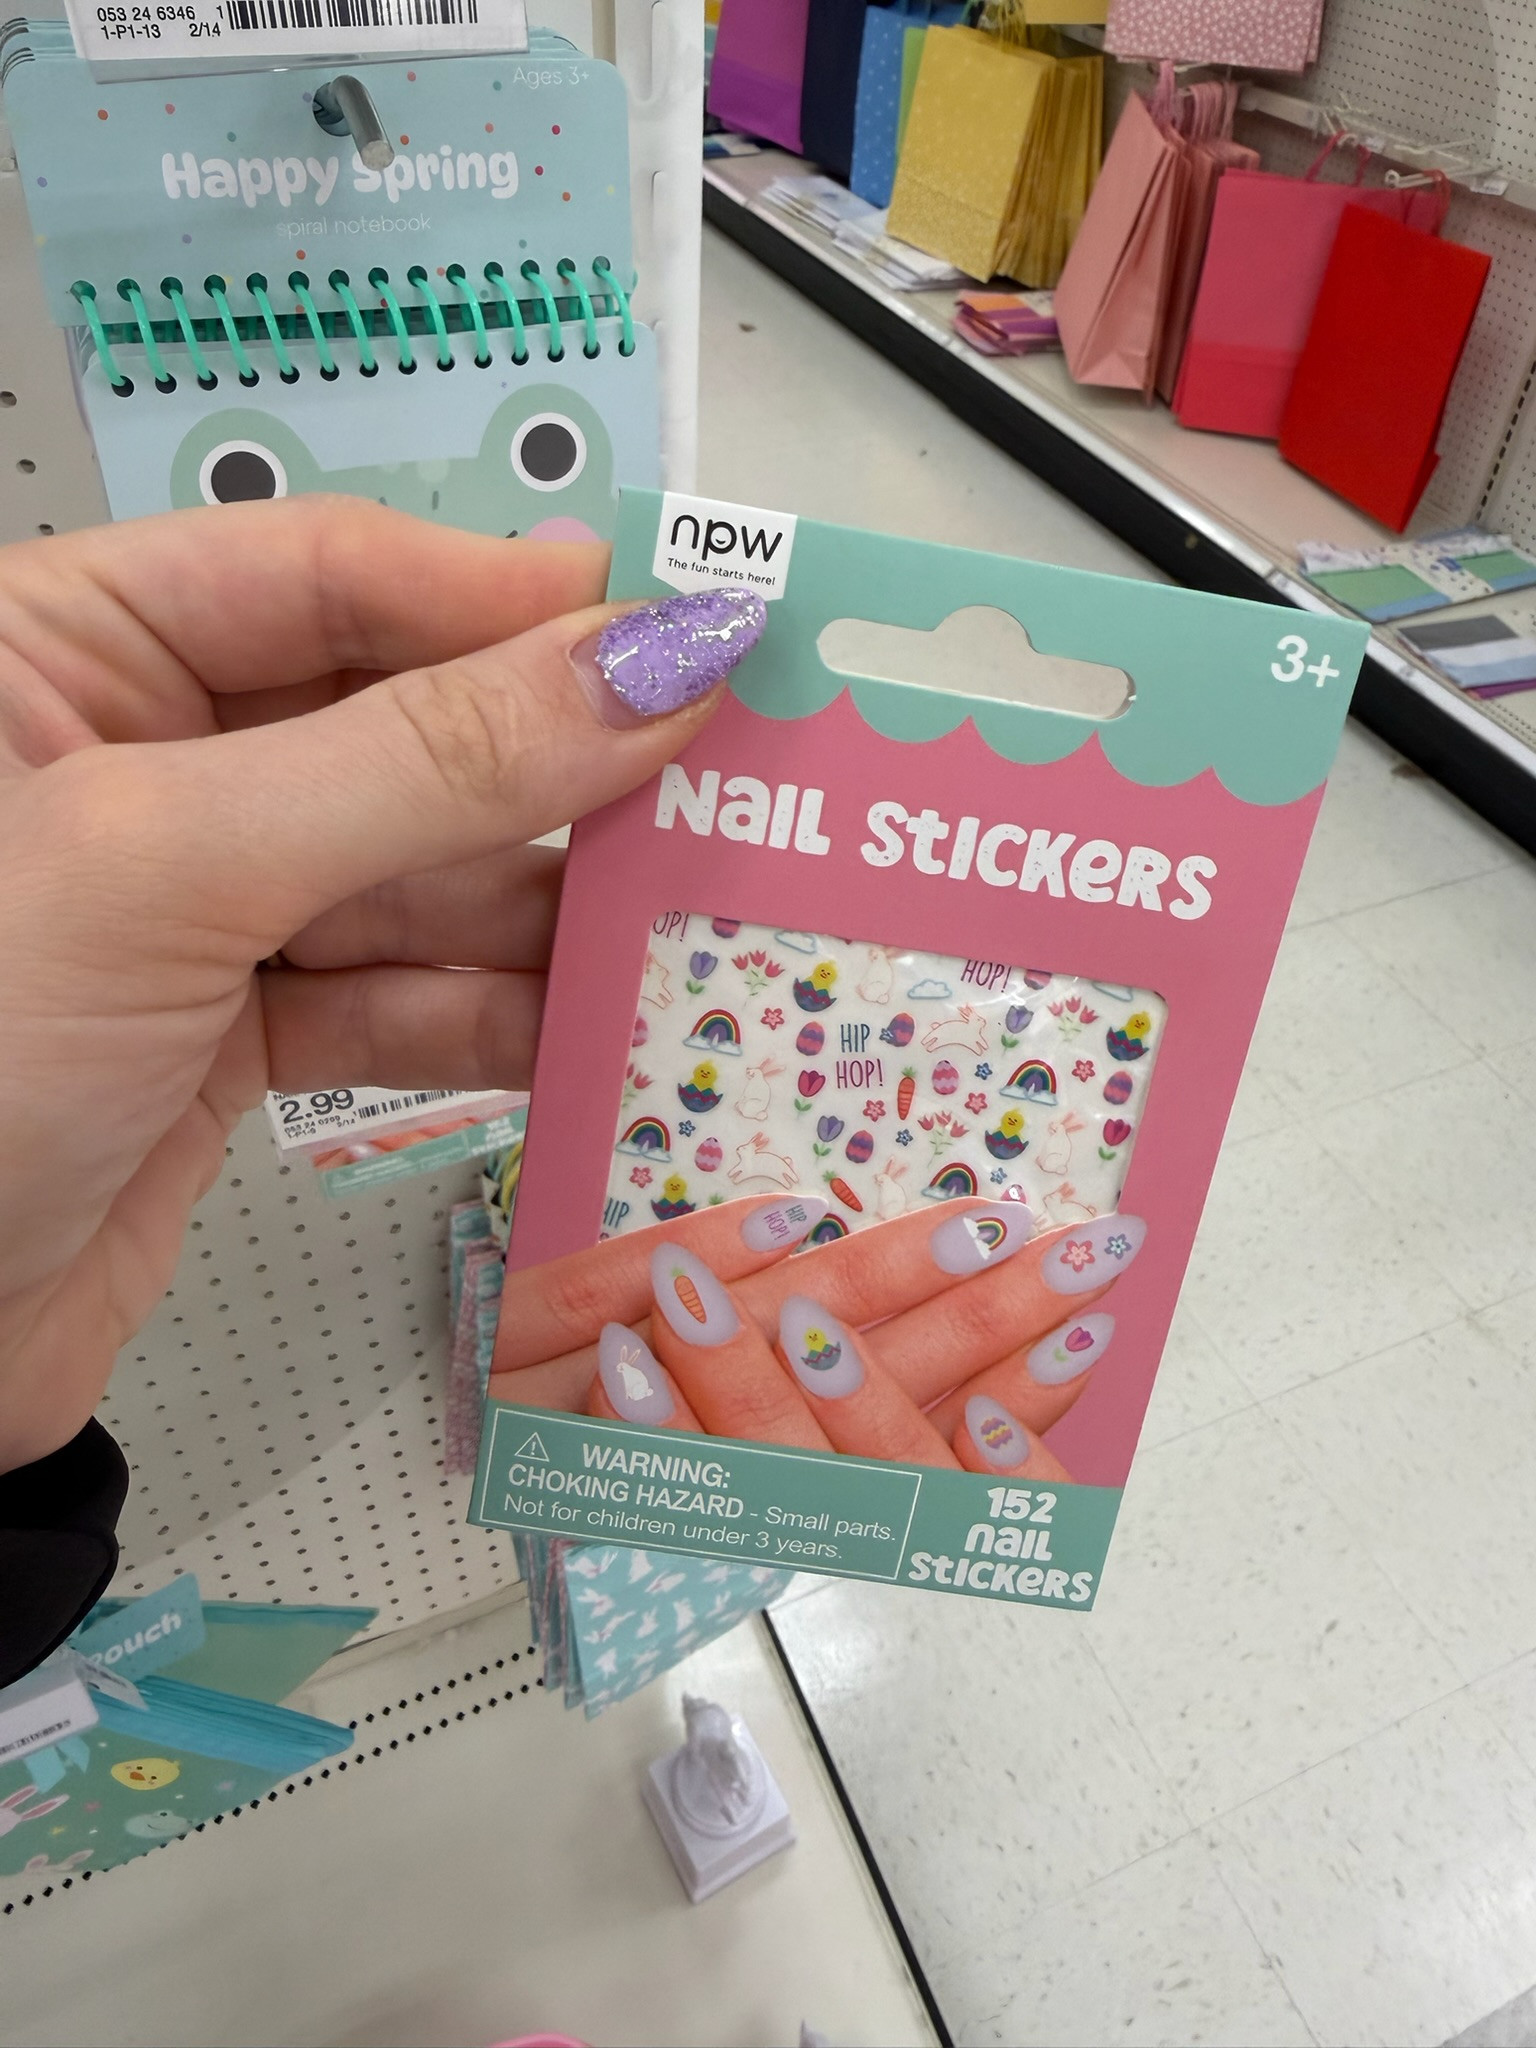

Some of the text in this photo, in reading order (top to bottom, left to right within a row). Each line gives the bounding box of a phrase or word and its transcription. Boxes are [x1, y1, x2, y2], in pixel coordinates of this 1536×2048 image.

[97, 7, 127, 22] 053
[132, 7, 152, 21] 24
[156, 6, 196, 21] 6346
[100, 24, 162, 40] 1-P1-13
[513, 66, 591, 90] Ages 3+
[161, 144, 520, 208] Happy Spring
[276, 213, 432, 239] spiral notebook
[670, 514, 783, 562] npw
[667, 557, 776, 586] The fun starts here!
[1270, 633, 1341, 688] 3+
[960, 958, 1013, 993] HOP!
[839, 1023, 871, 1053] HIP
[835, 1058, 884, 1089] HOP!
[279, 1089, 355, 1125] 2.99
[763, 1210, 791, 1241] HOP!
[785, 1204, 807, 1224] HIP
[583, 1442, 731, 1489] WARNING:
[508, 1463, 629, 1503] CHOKING
[635, 1487, 744, 1520] HAZARD
[764, 1505, 830, 1532] Small
[835, 1519, 897, 1543] parts.
[986, 1485, 1058, 1524] 152
[504, 1494, 843, 1562] Not for children under 3 years.
